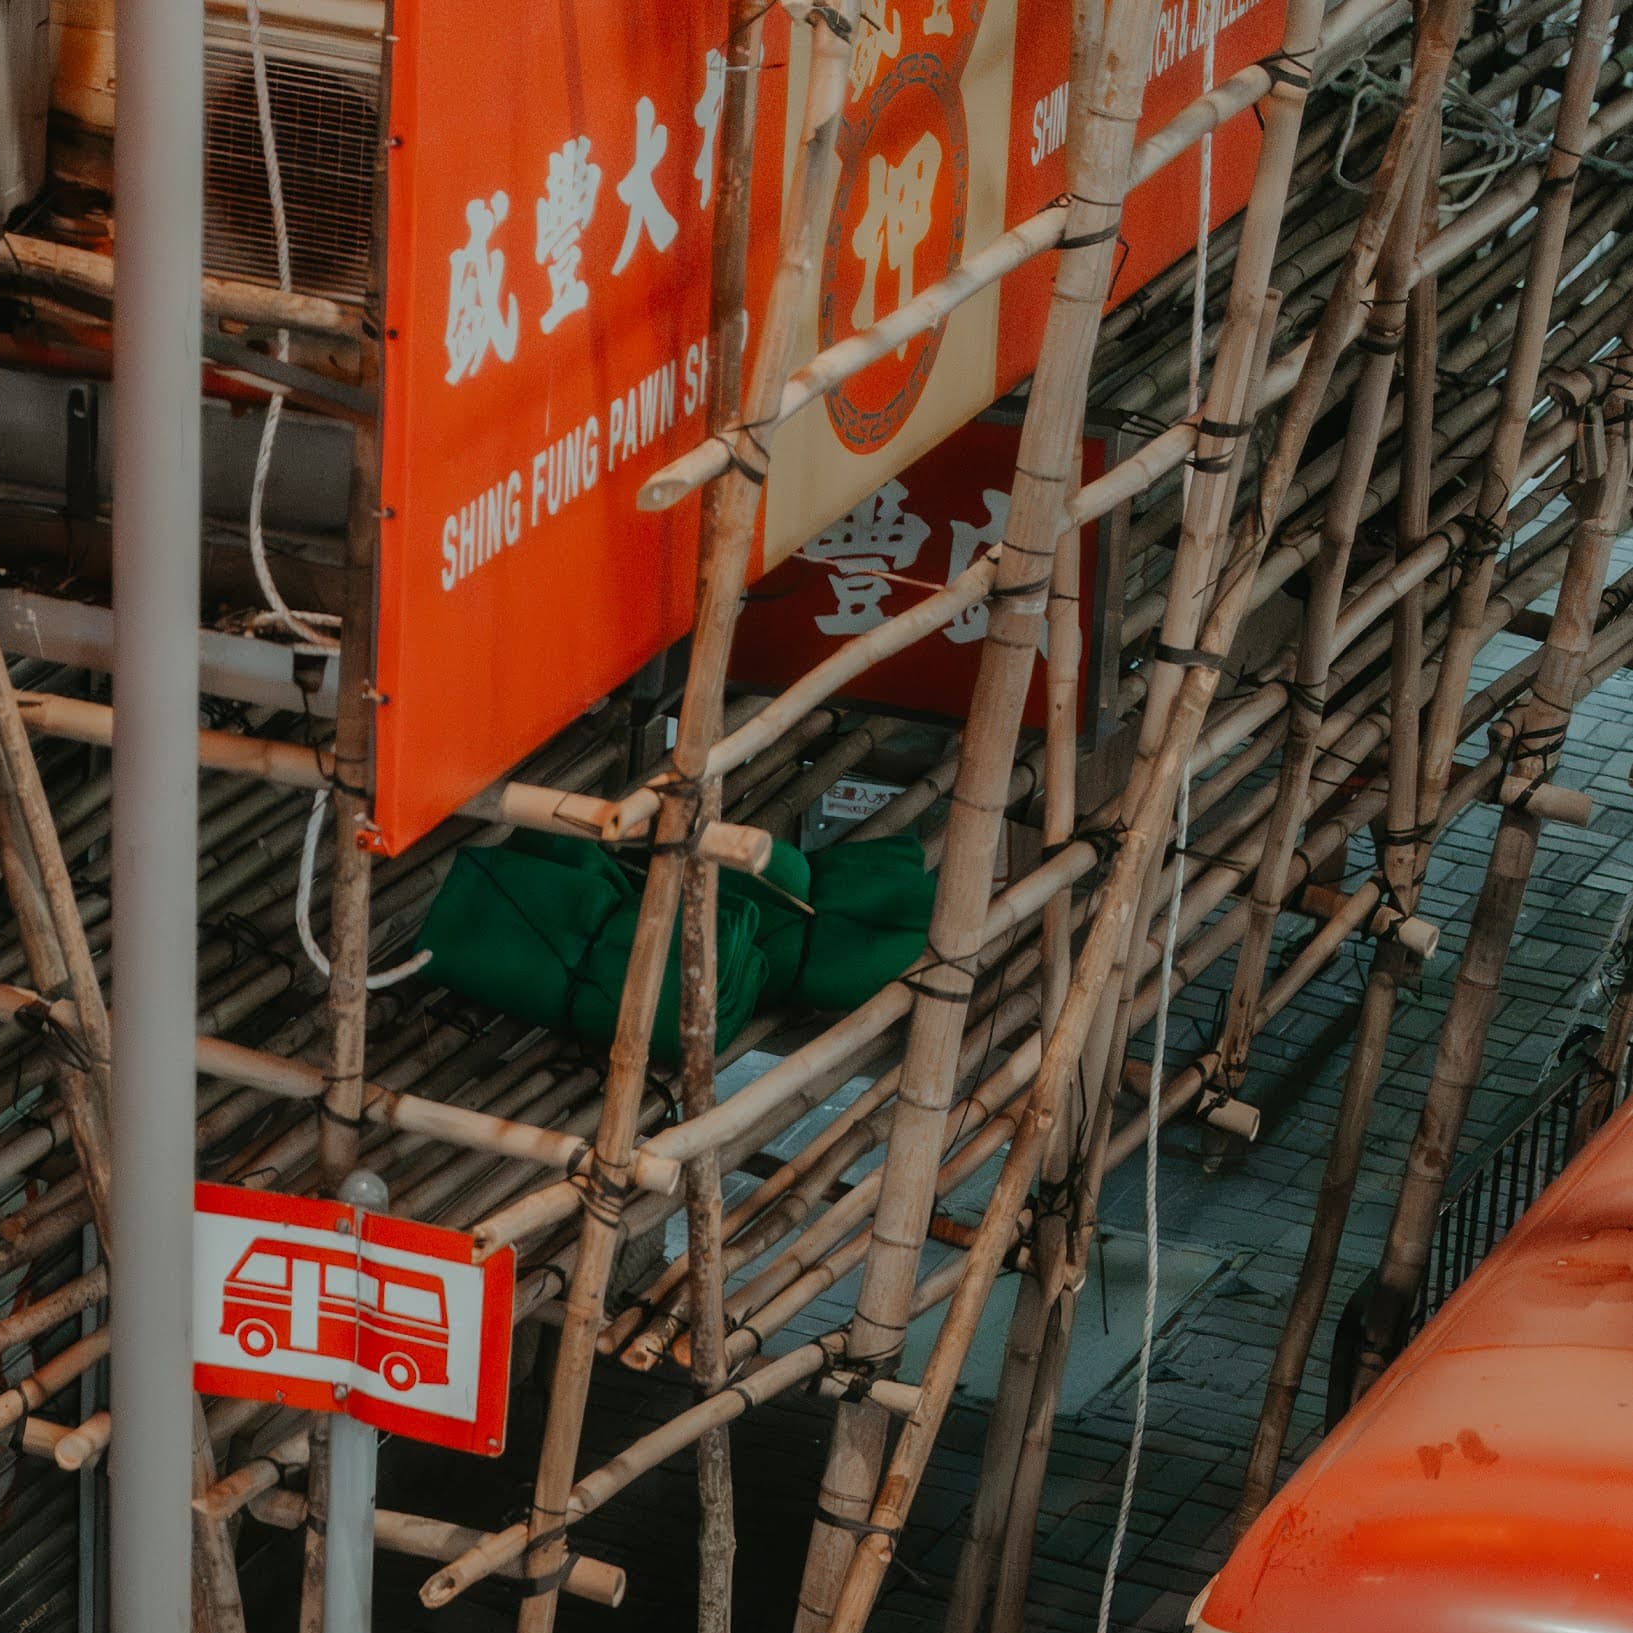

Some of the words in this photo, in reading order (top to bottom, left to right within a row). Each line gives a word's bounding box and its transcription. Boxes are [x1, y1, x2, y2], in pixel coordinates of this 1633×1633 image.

[444, 40, 768, 386] 盛豐大
[1031, 80, 1070, 166] SHIN
[441, 469, 522, 592] SHING
[531, 415, 599, 527] FUNG
[608, 359, 676, 472] PAWN
